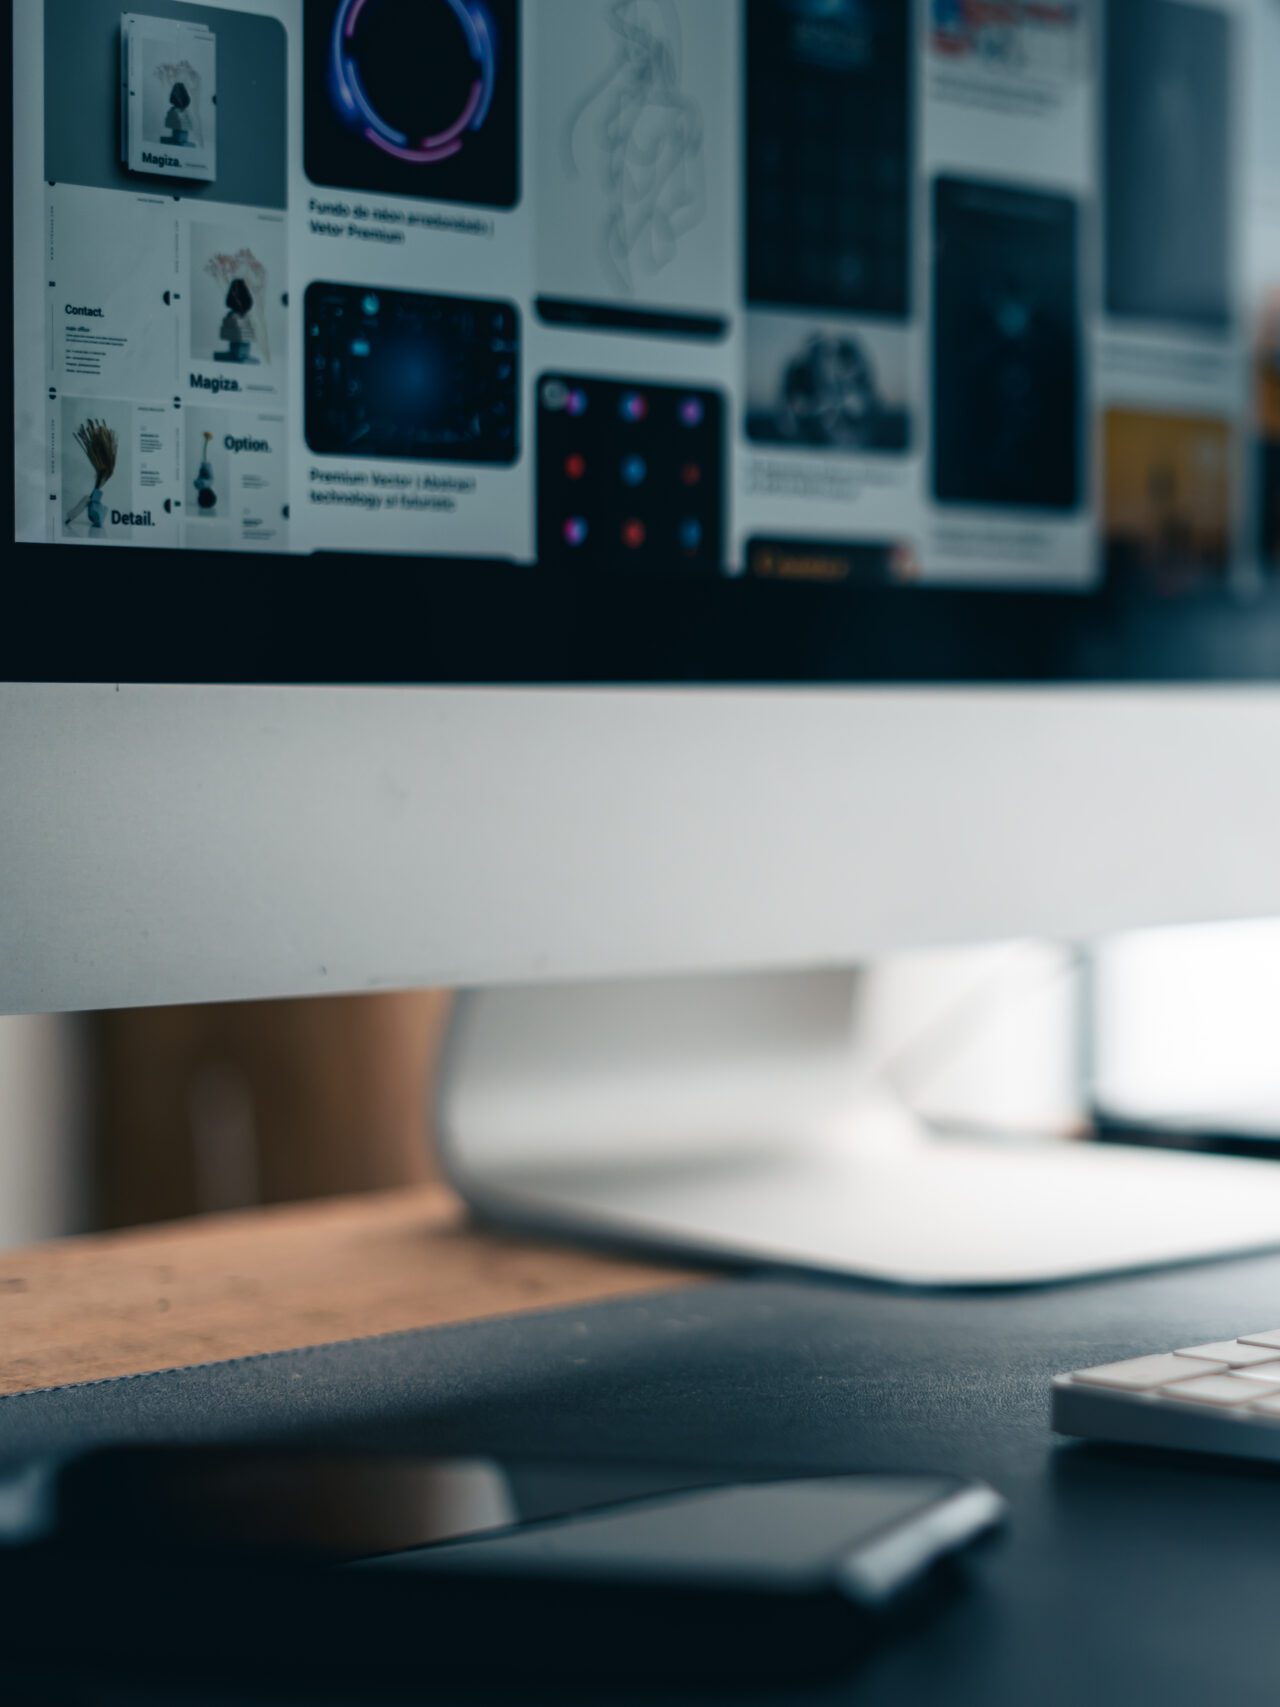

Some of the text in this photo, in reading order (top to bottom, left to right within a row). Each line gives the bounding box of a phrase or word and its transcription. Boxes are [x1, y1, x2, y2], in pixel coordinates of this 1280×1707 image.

[142, 151, 182, 168] Magiza.
[309, 198, 350, 216] Fundo
[353, 205, 370, 218] de
[310, 219, 405, 243] Vetor Premium
[65, 304, 104, 318] Contact.
[190, 373, 242, 394] Magiza.
[224, 434, 272, 455] Option.
[309, 467, 368, 485] Premium
[371, 471, 412, 488] Vector
[310, 490, 384, 511] technology
[111, 510, 156, 527] Detail.
